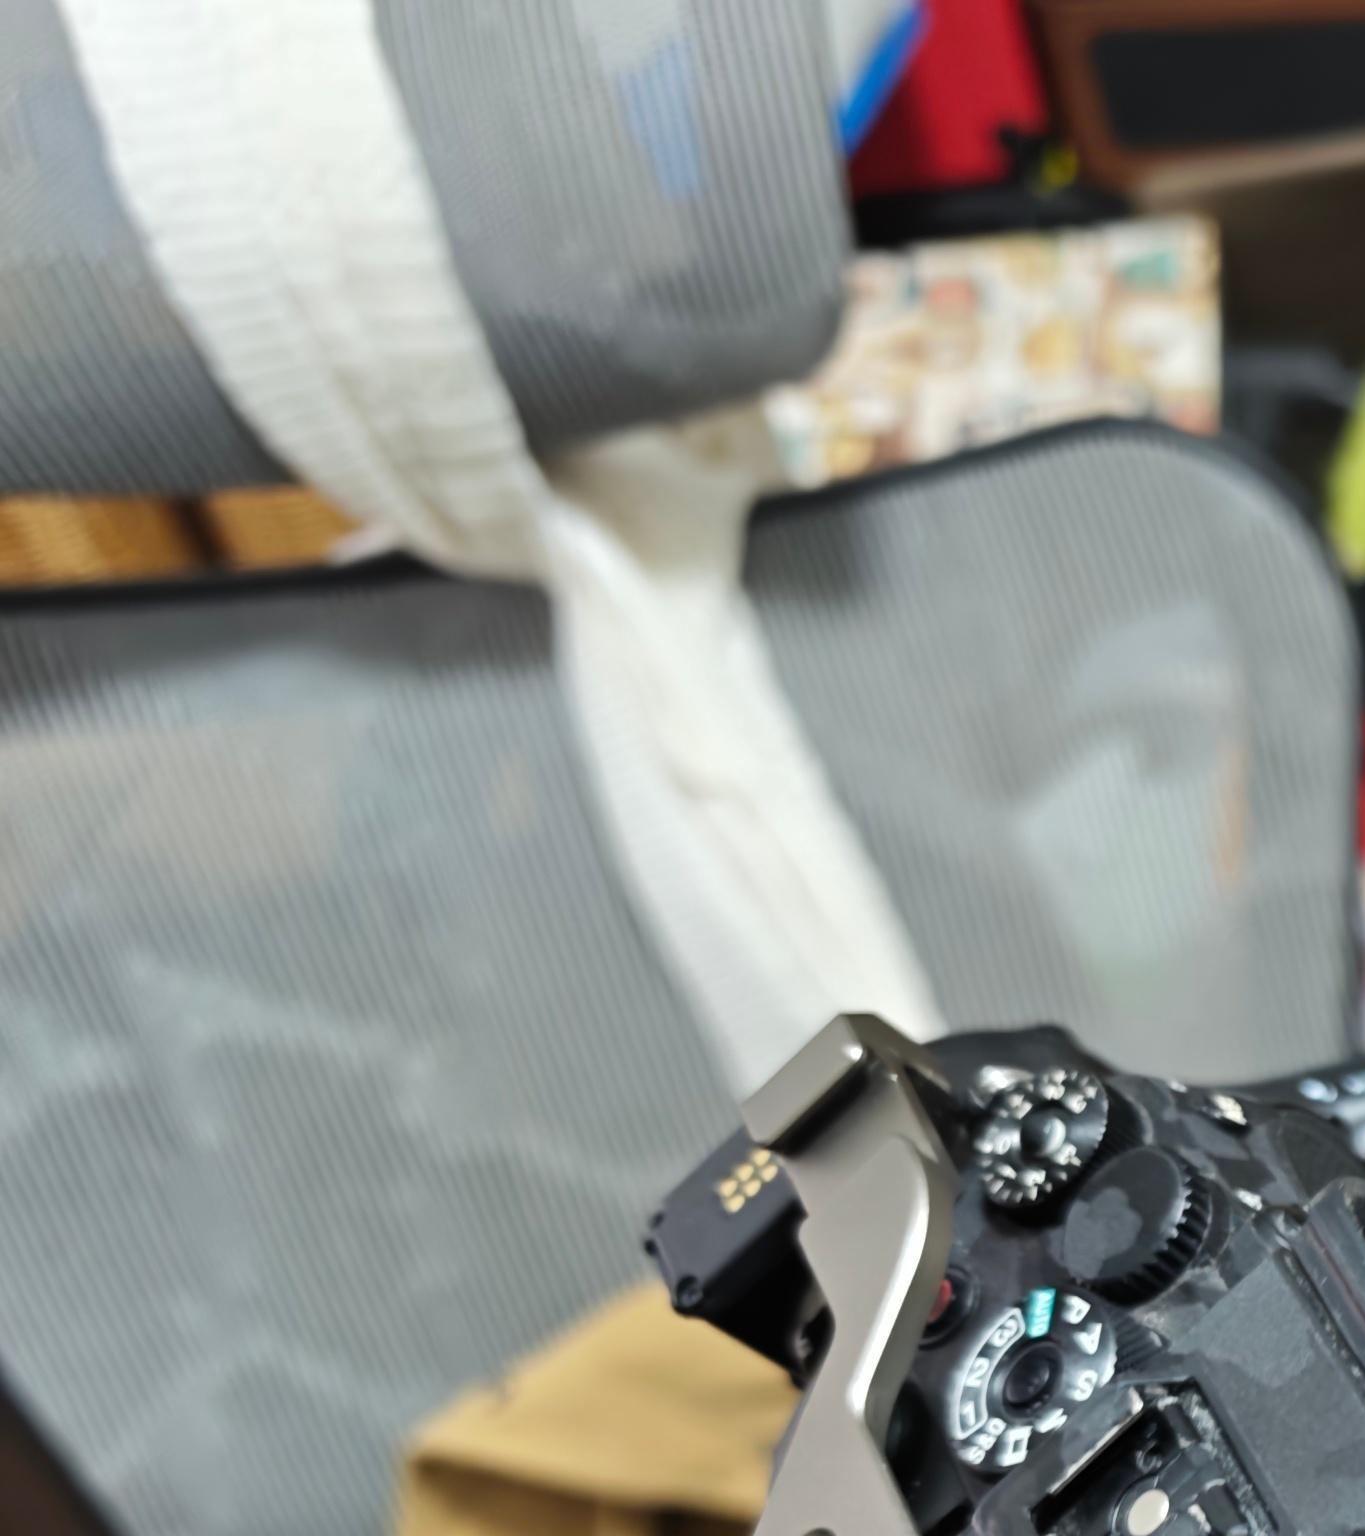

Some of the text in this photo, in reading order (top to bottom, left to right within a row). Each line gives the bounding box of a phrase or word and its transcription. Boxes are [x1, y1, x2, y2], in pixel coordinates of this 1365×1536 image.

[1028, 1290, 1055, 1337] AUTO
[1073, 1322, 1102, 1355] A
[966, 1356, 990, 1387] 2
[1071, 1370, 1098, 1401] S
